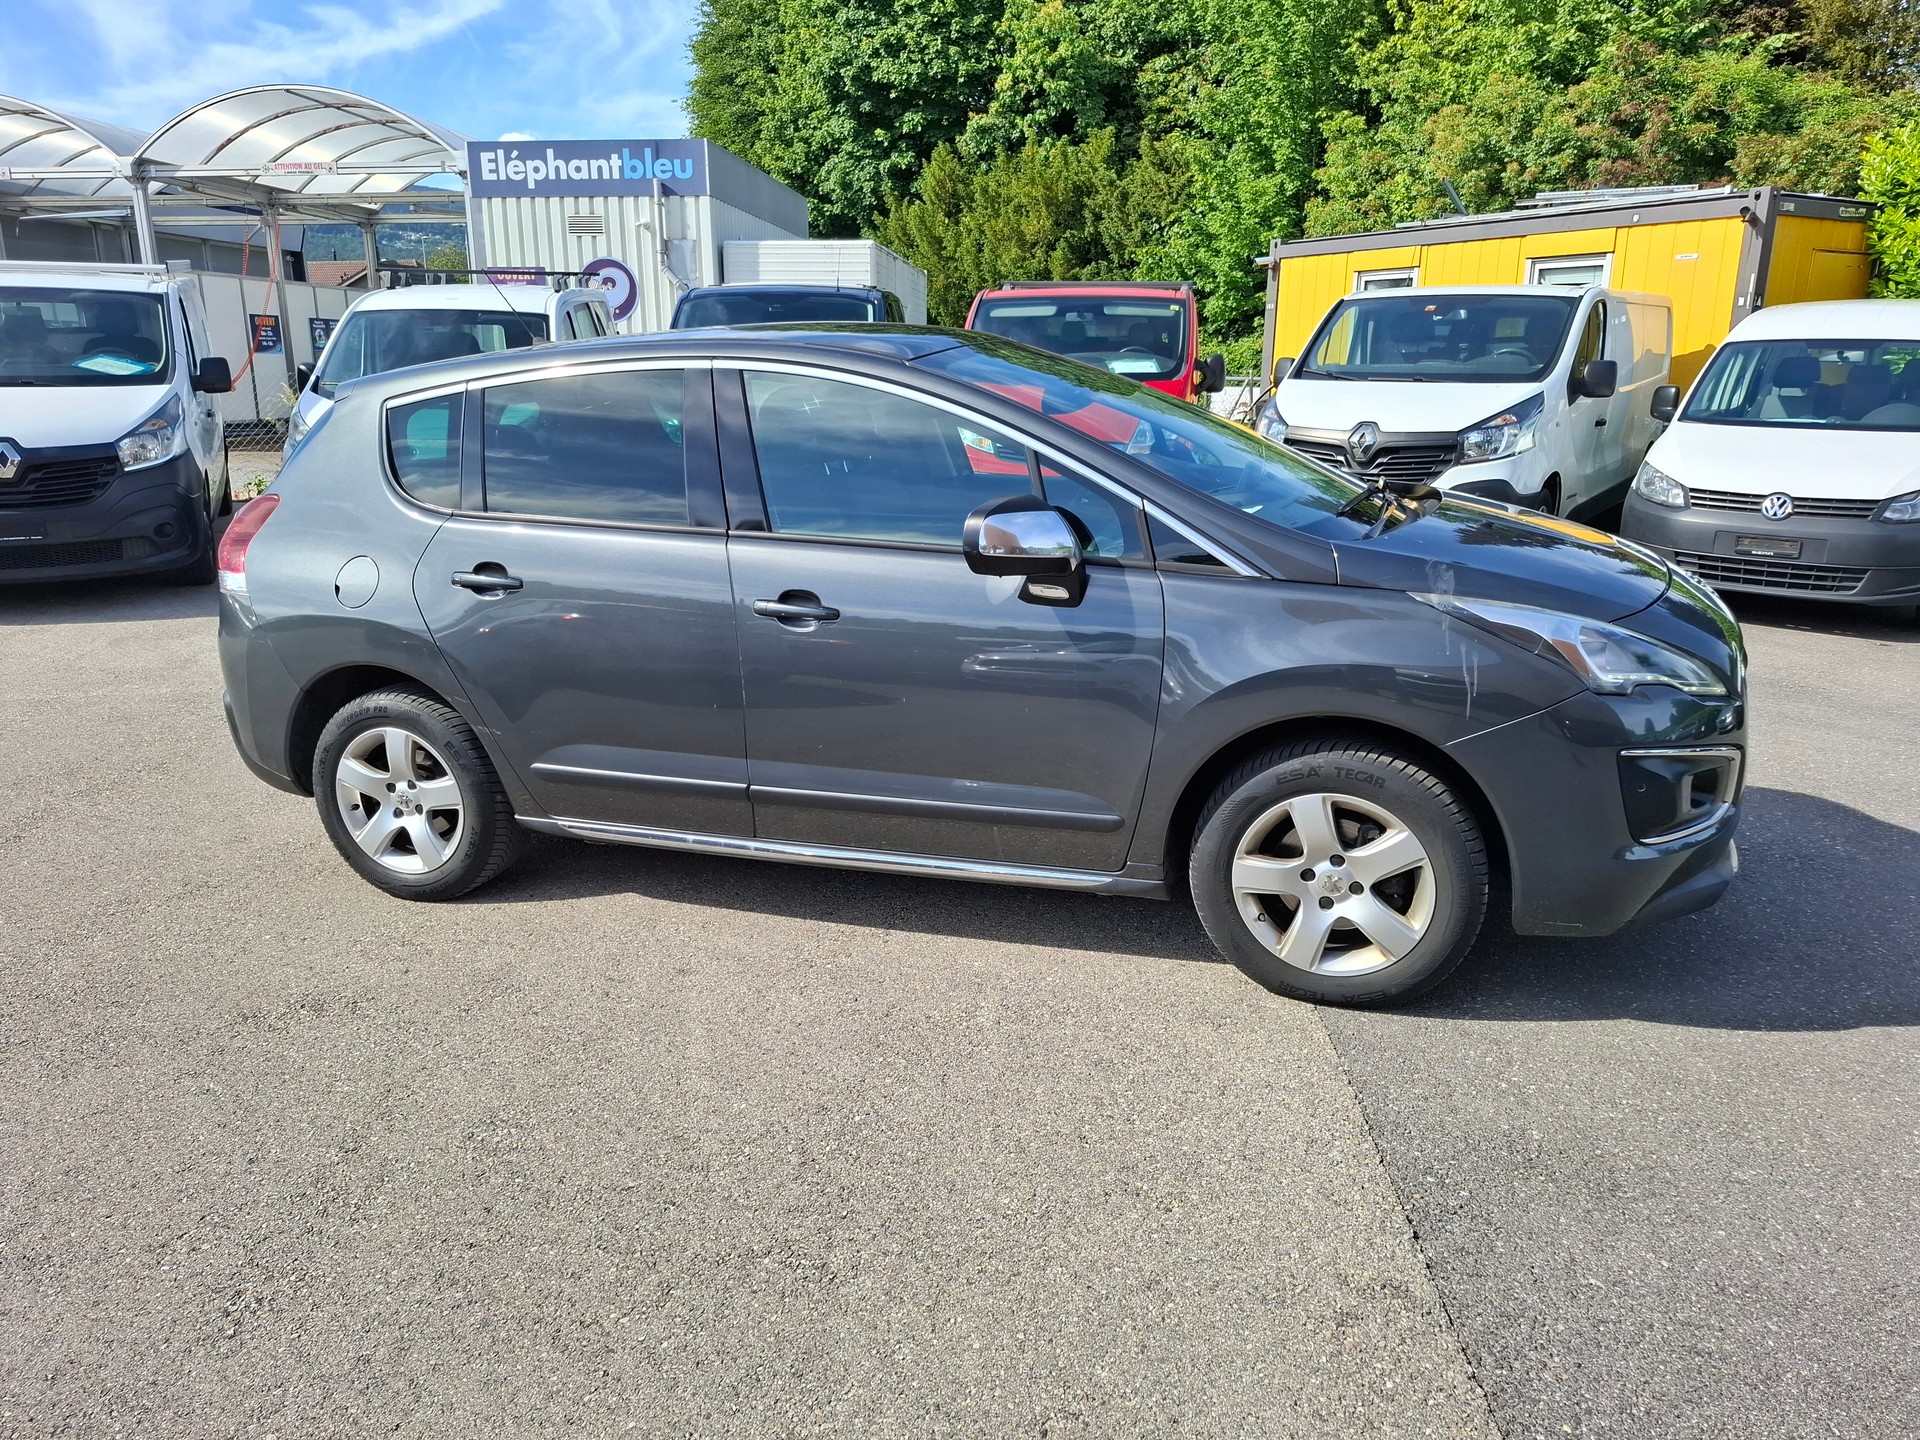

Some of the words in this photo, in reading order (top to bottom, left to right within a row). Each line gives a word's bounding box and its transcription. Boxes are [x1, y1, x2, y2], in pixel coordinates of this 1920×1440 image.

[274, 162, 303, 170] ATTENTION
[303, 162, 313, 170] AU
[313, 162, 324, 170] GEL
[335, 708, 371, 731] SUPERGRIP
[373, 706, 388, 714] PRO
[1333, 766, 1387, 790] TECAR
